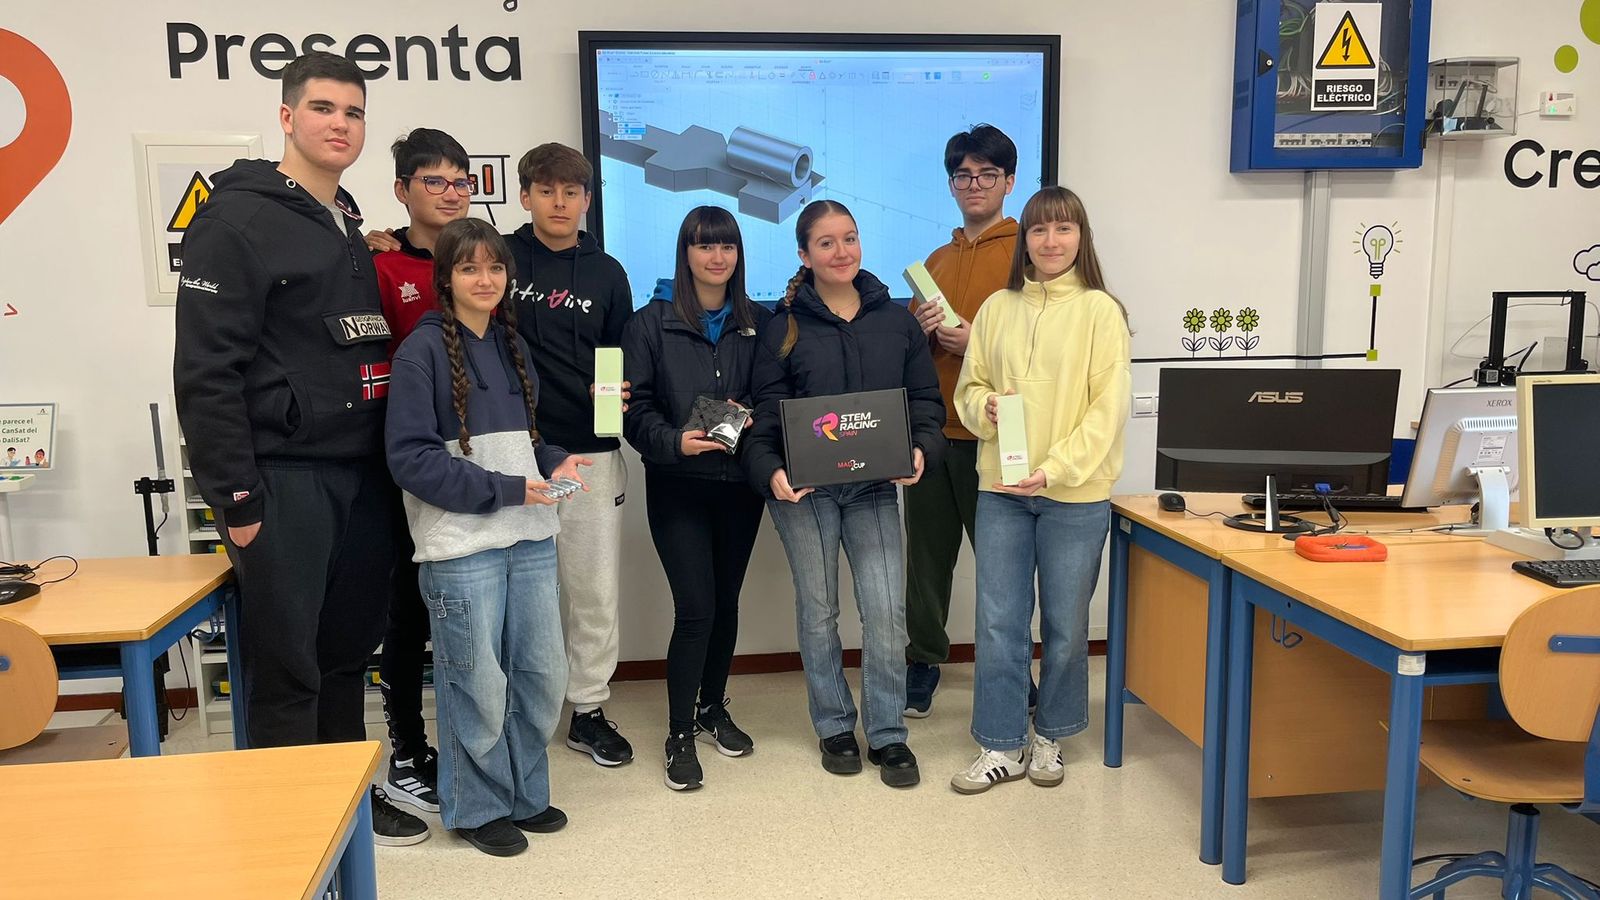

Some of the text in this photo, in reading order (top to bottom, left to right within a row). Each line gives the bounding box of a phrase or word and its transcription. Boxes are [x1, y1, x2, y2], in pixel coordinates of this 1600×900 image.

[1326, 84, 1363, 93] RIESGO
[1316, 92, 1372, 102] ELÉCTRICO
[1504, 139, 1600, 189] Cre
[173, 258, 183, 267] E
[1248, 391, 1304, 403] ASUS
[840, 412, 871, 422] STEM
[839, 420, 878, 431] RACING
